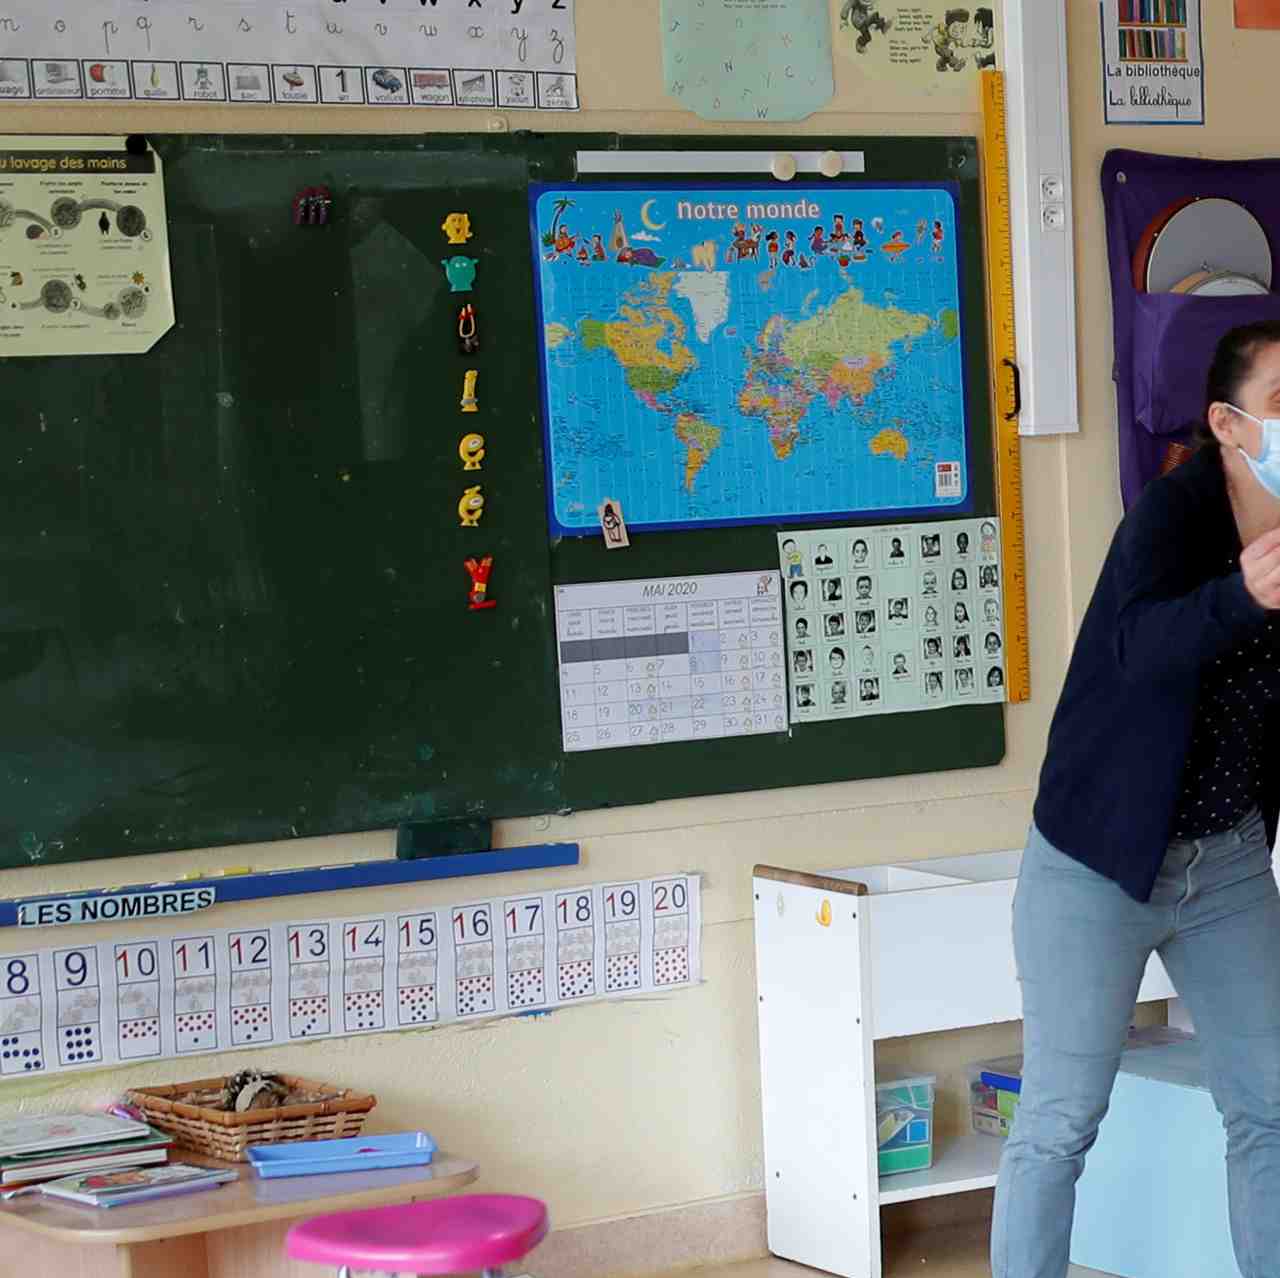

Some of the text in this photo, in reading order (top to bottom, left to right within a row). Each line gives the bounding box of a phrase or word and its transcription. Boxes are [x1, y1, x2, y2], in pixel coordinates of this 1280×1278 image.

[1107, 64, 1201, 80] La bibliothèque
[1109, 88, 1125, 106] La
[10, 156, 57, 172] lavage
[60, 156, 85, 170] des
[87, 156, 128, 170] mains
[746, 198, 820, 220] monde
[642, 581, 698, 598] MAI 2020
[19, 889, 213, 926] LES NOMBRES
[6, 884, 688, 995] 8 9 10 11 12 13 14 15 16 17 18 19 20
